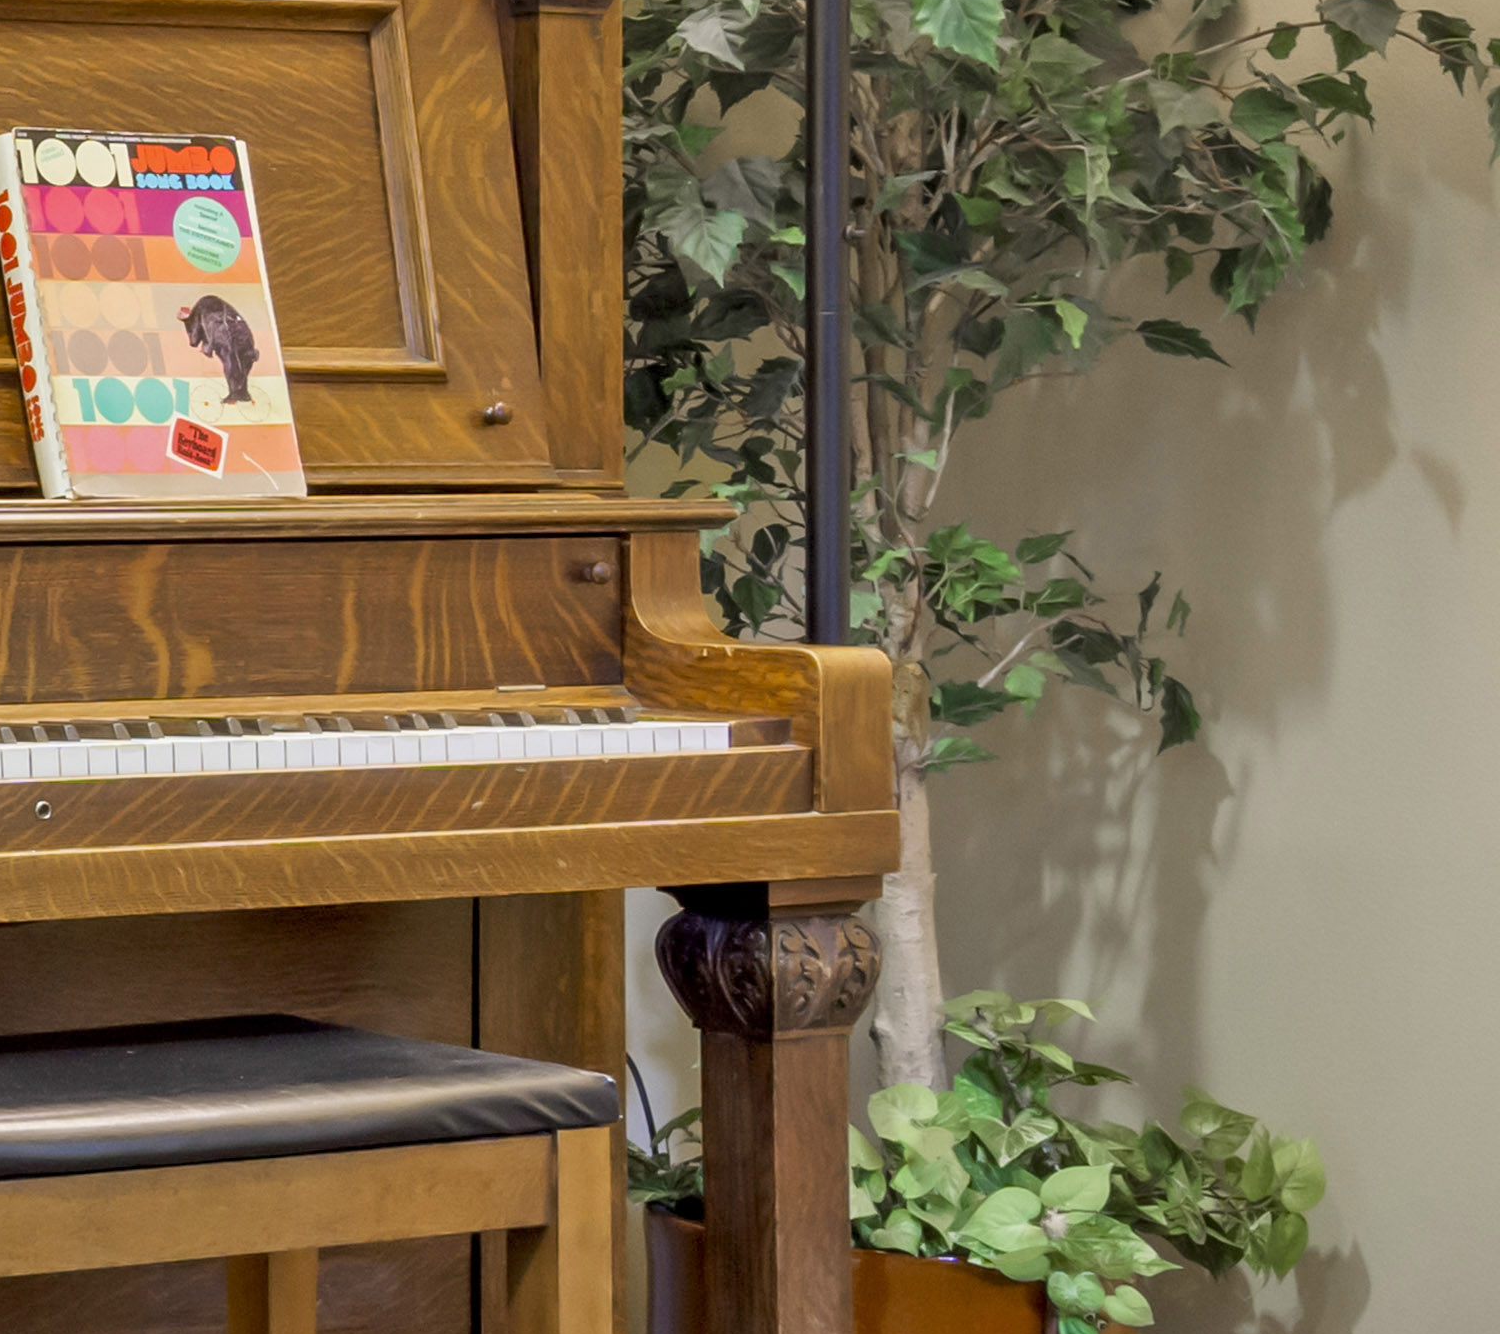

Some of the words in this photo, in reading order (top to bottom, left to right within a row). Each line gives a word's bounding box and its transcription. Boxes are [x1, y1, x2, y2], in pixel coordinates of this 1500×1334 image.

[15, 137, 135, 188] 1001
[131, 144, 236, 175] JUMBO
[136, 172, 183, 190] SONG
[186, 174, 235, 191] BOOK
[24, 186, 142, 234] 1001
[31, 232, 150, 281] 1001
[6, 277, 37, 393] JUMBO
[50, 330, 167, 377] 1001
[72, 376, 191, 425] 1001
